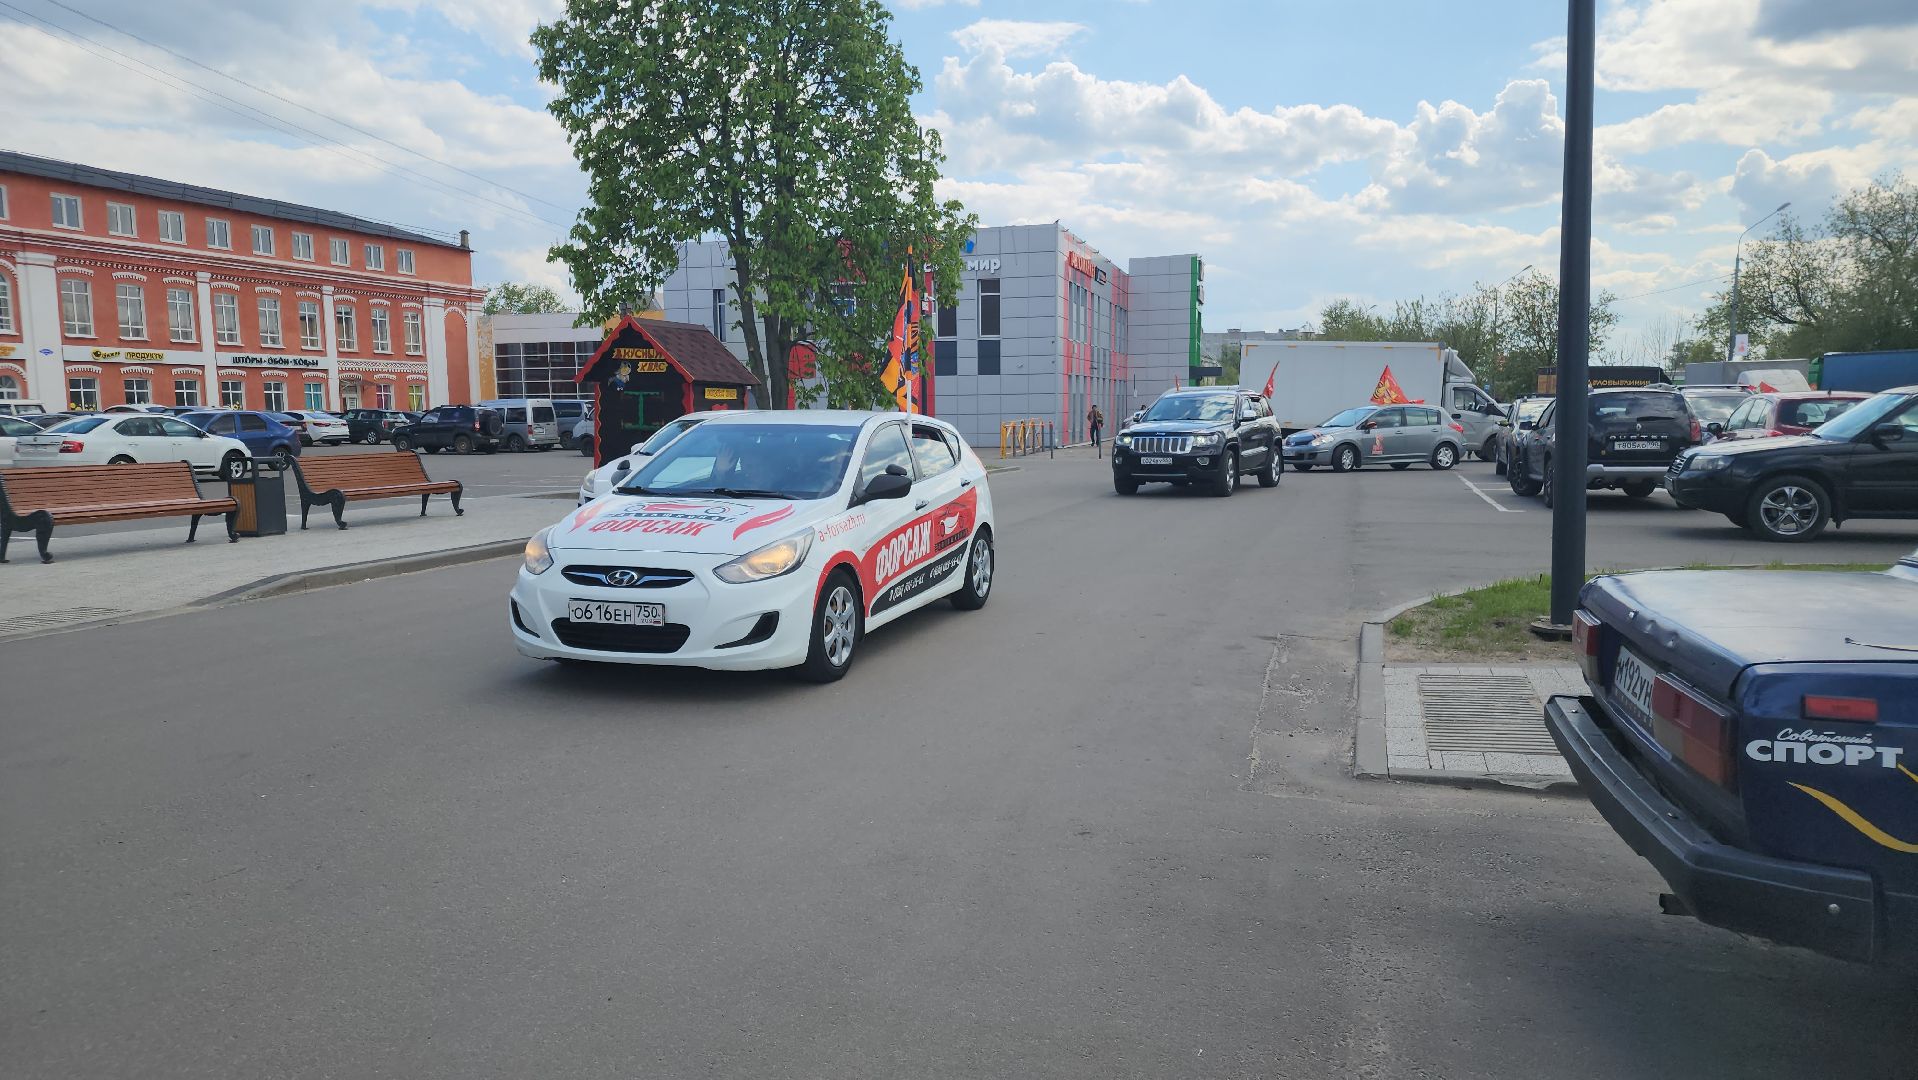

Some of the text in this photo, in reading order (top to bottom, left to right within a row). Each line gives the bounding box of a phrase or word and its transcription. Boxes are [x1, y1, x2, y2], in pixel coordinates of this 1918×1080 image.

[967, 259, 1001, 274] мир
[125, 351, 164, 361] ПРОДУКТЫ
[232, 355, 263, 364] ШТОРЫ
[267, 356, 290, 366] ОБОИ
[639, 362, 667, 372] КВАС
[588, 518, 715, 537] ФОРСАЖ
[875, 519, 932, 586] ФОРСАЖ
[1776, 727, 1874, 745] Советский
[1745, 739, 1904, 769] СПОРТ
